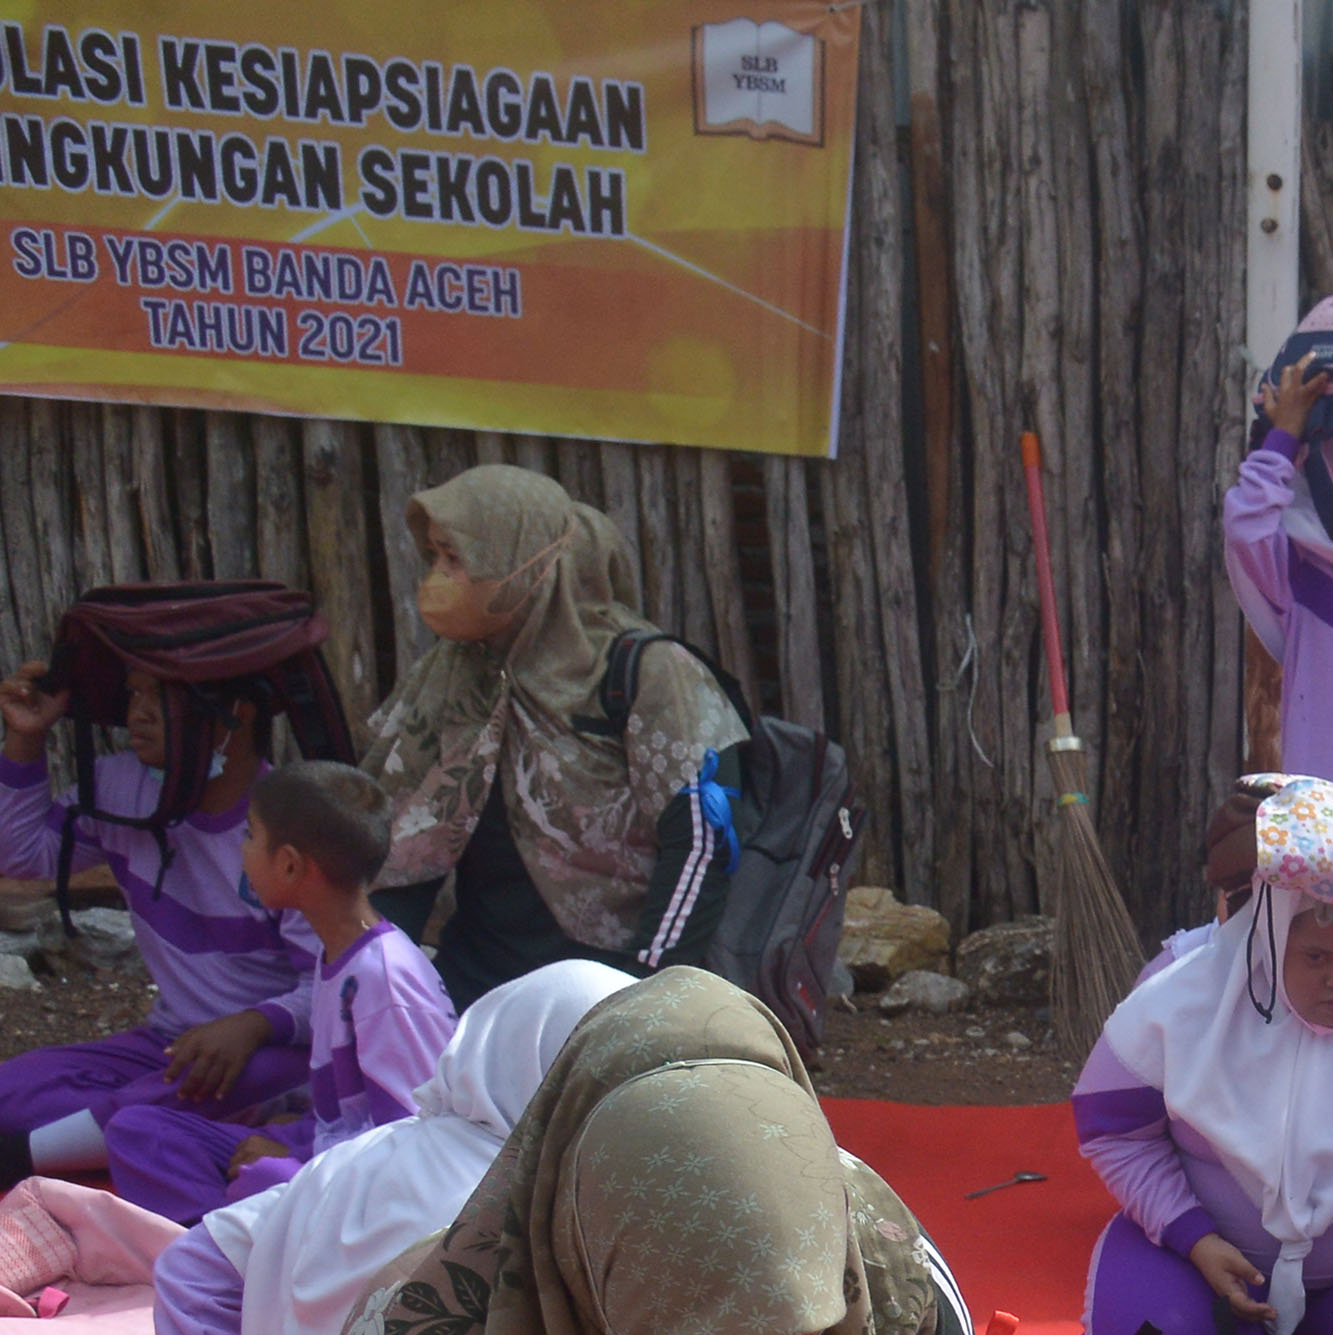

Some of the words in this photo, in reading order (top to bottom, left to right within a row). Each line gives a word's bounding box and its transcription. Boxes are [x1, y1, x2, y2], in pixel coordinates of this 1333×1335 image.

[0, 25, 145, 105] LASI
[161, 39, 645, 151] KESIAPSIAGAAN
[731, 73, 786, 94] YBSM
[741, 55, 778, 73] SLB
[0, 117, 343, 211] NGKUNGAN
[361, 151, 627, 236] SEKOLAH
[14, 230, 96, 282] SLB
[105, 237, 231, 294] YBSM
[246, 248, 394, 307] BANDA
[405, 264, 521, 317] ACEH
[143, 299, 288, 357] TAHUN
[299, 314, 401, 365] 2021
